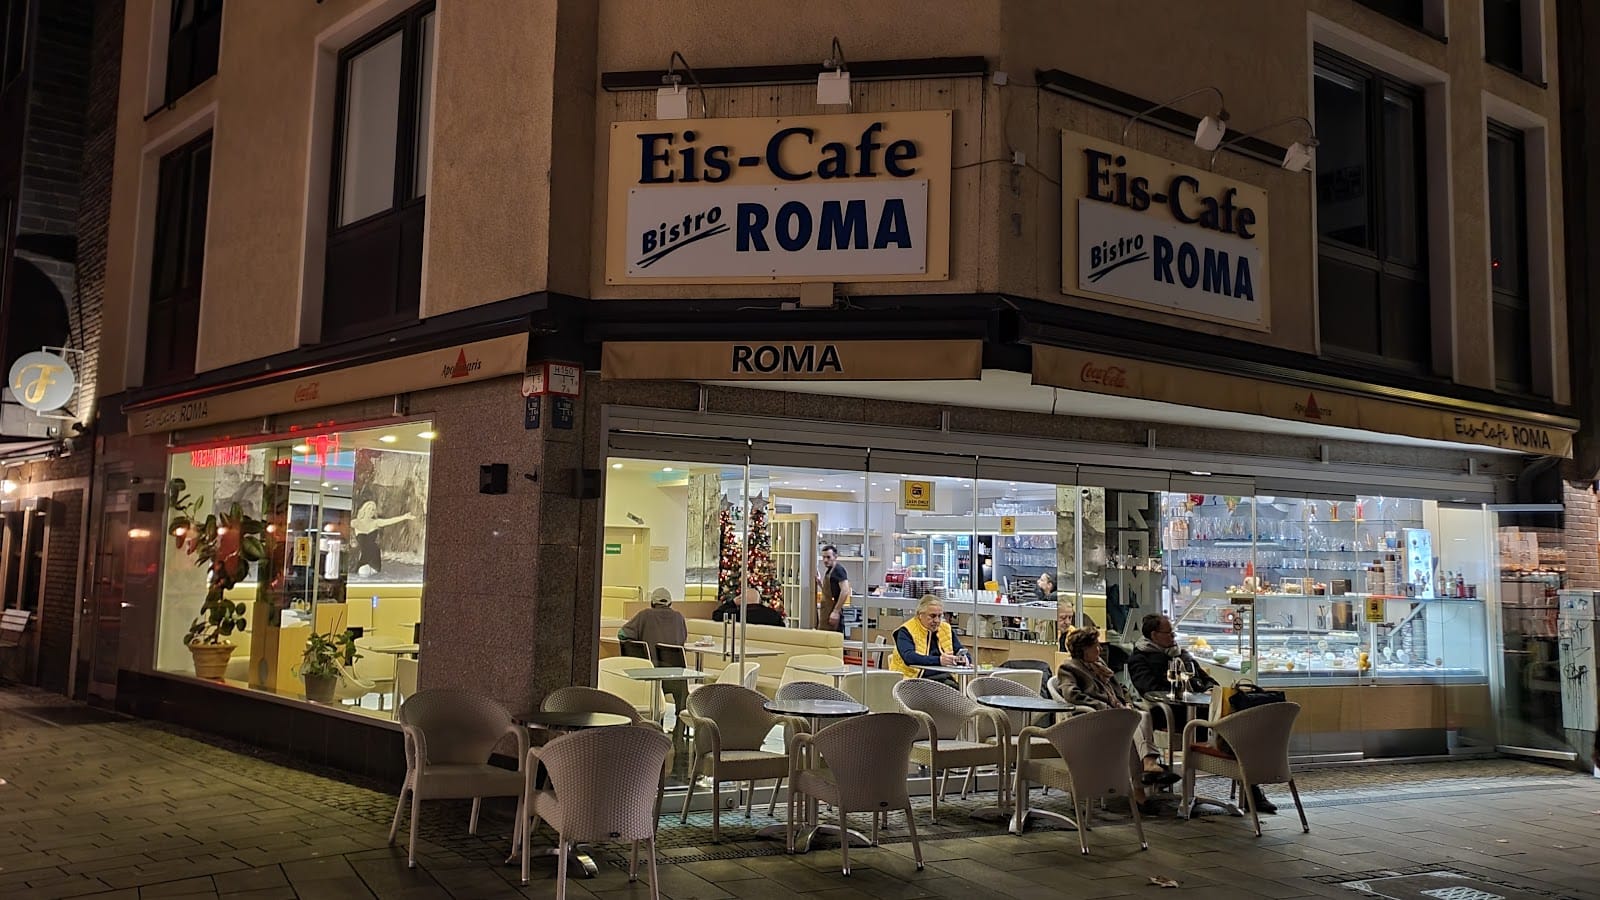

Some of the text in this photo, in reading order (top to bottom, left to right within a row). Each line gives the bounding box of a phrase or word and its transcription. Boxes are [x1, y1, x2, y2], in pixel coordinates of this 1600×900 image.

[637, 122, 918, 184] Eis-Cafe
[1083, 148, 1256, 239] Eis-Cafe
[642, 198, 913, 255] Bistro ROMA
[1091, 234, 1254, 301] Bistro ROMA
[731, 344, 844, 374] ROMA
[1454, 416, 1552, 450] Eis-Cafe ROMA
